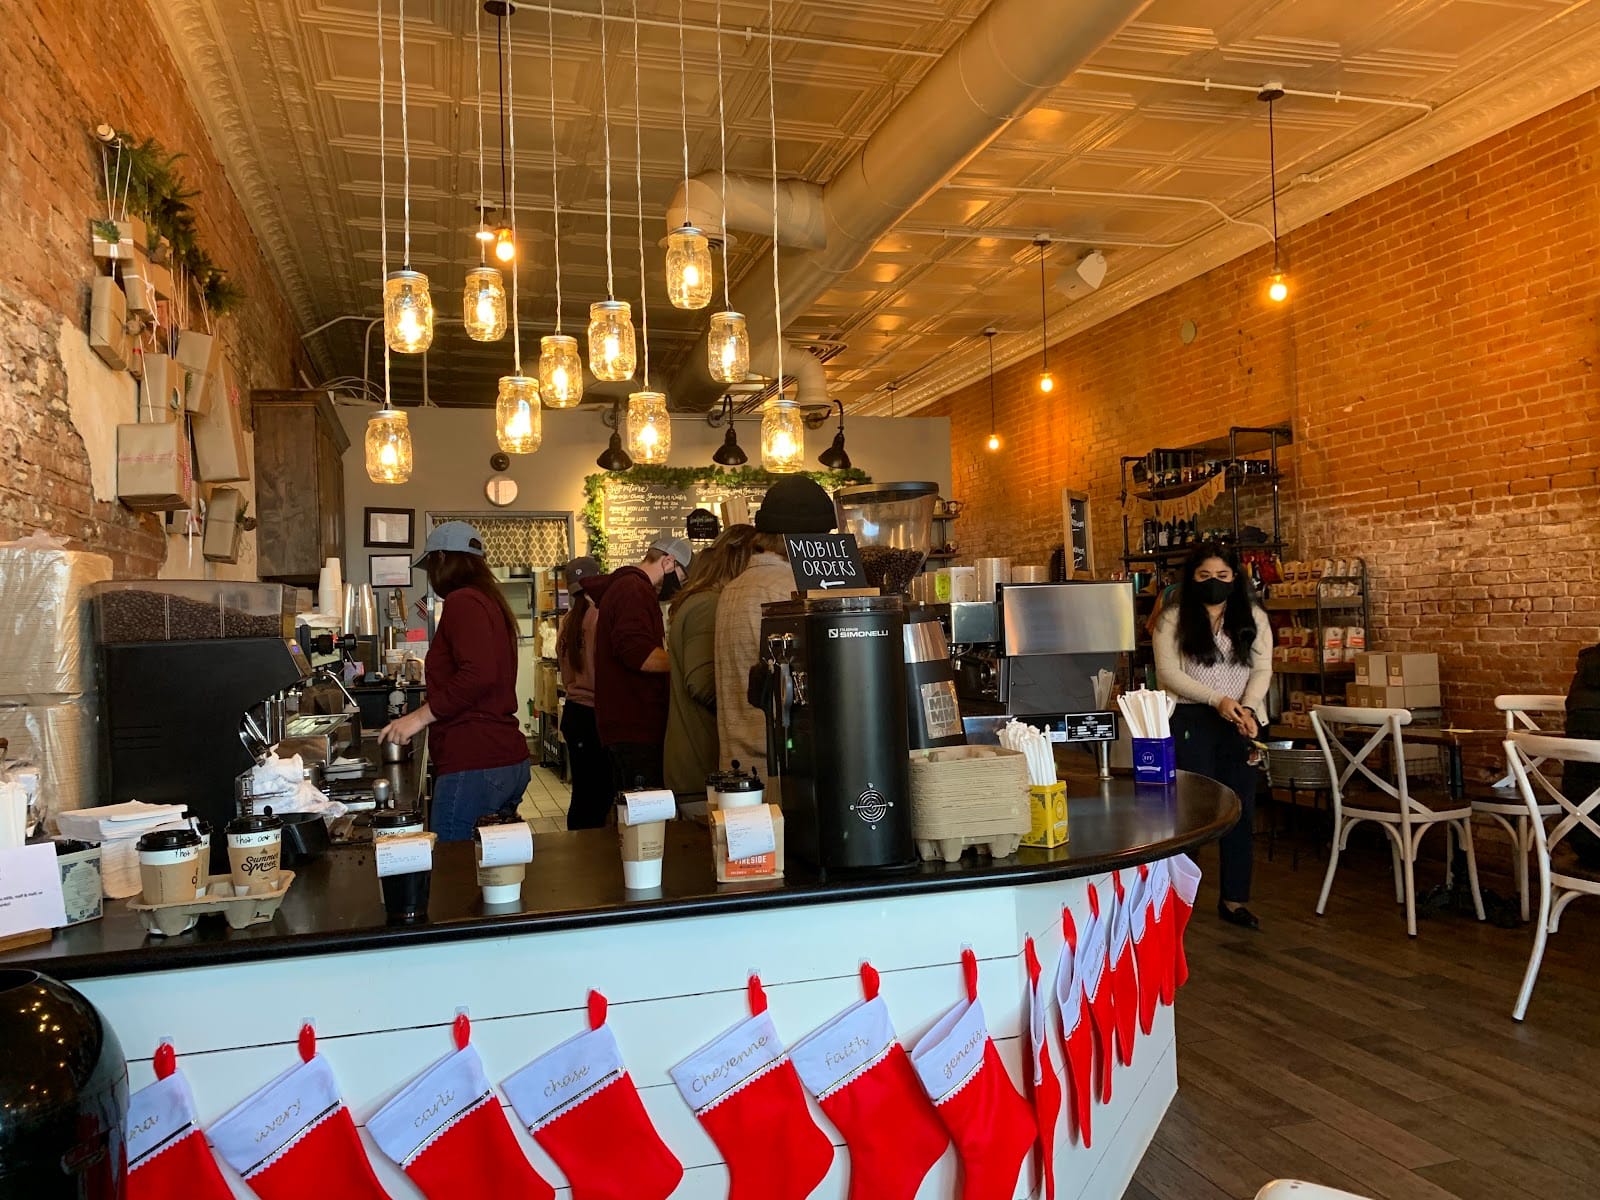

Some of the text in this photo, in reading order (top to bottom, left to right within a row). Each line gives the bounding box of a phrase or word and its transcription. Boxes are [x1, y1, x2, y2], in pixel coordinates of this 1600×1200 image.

[789, 539, 850, 558] MOBILE
[802, 560, 857, 577] ORDERS
[839, 630, 889, 639] SIMONELLI
[692, 1034, 769, 1093] Cheyenne
[823, 1035, 871, 1071] faith
[543, 1064, 591, 1099] chase
[413, 1089, 456, 1129] carli
